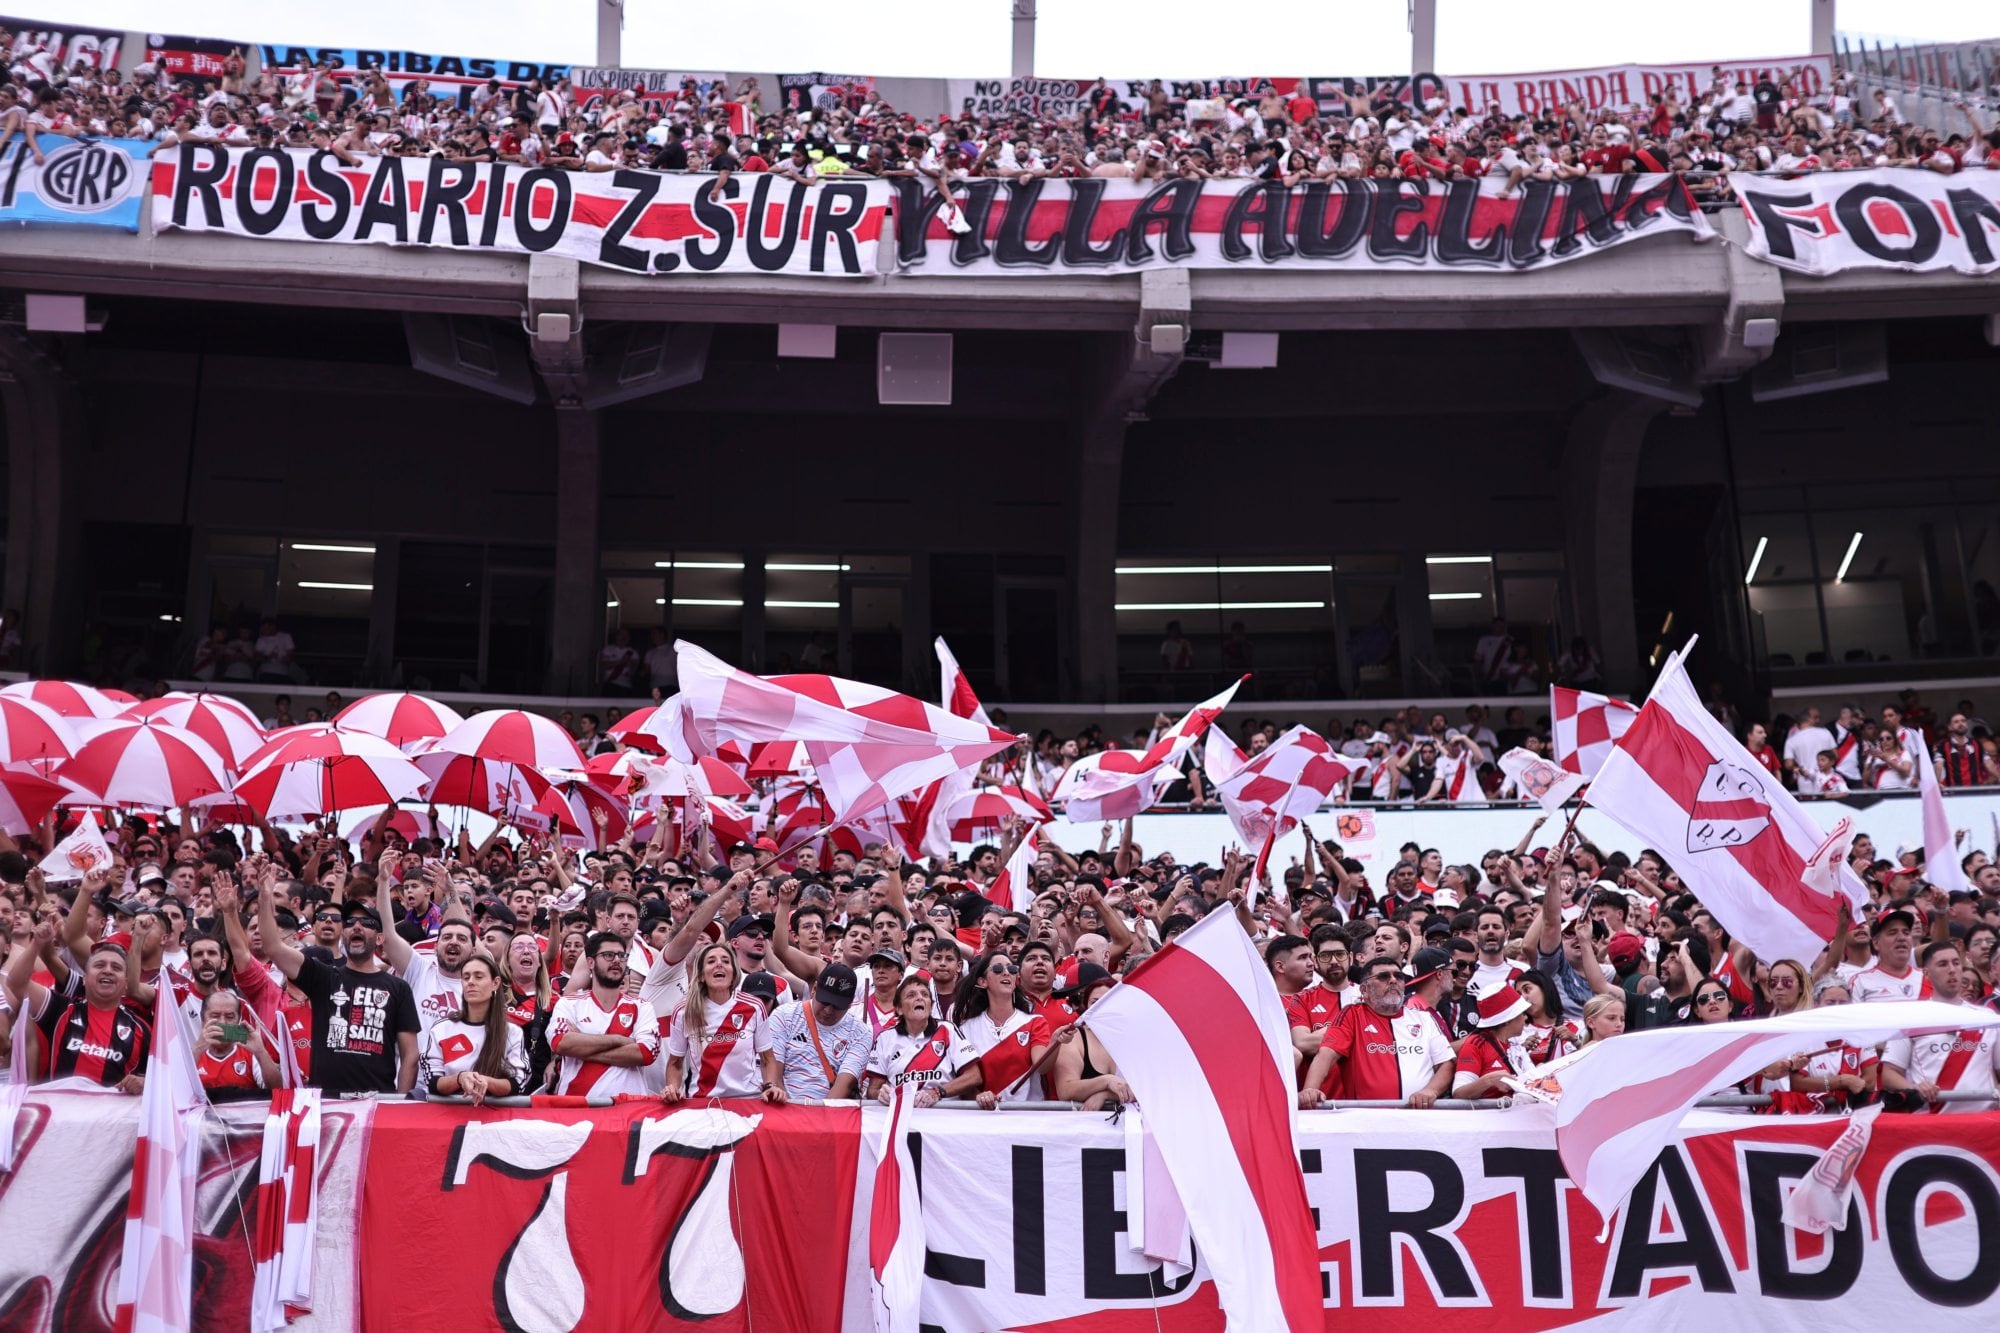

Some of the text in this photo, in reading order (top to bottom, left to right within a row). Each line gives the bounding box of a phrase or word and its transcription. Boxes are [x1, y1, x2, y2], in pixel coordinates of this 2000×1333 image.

[262, 45, 343, 71] LAS
[507, 61, 569, 86] DE
[581, 69, 667, 92] LOS PIBES DE
[975, 79, 1076, 97] NO PUEDO
[1458, 81, 1501, 116] LA
[1514, 70, 1630, 117] BANDA
[963, 96, 1033, 114] PARAR
[172, 142, 572, 252] ROSARIO
[353, 986, 374, 1006] EL
[348, 1024, 385, 1045] SALTA
[66, 1037, 123, 1062] Betano
[1367, 1041, 1424, 1055] codere
[895, 1069, 943, 1087] Betano
